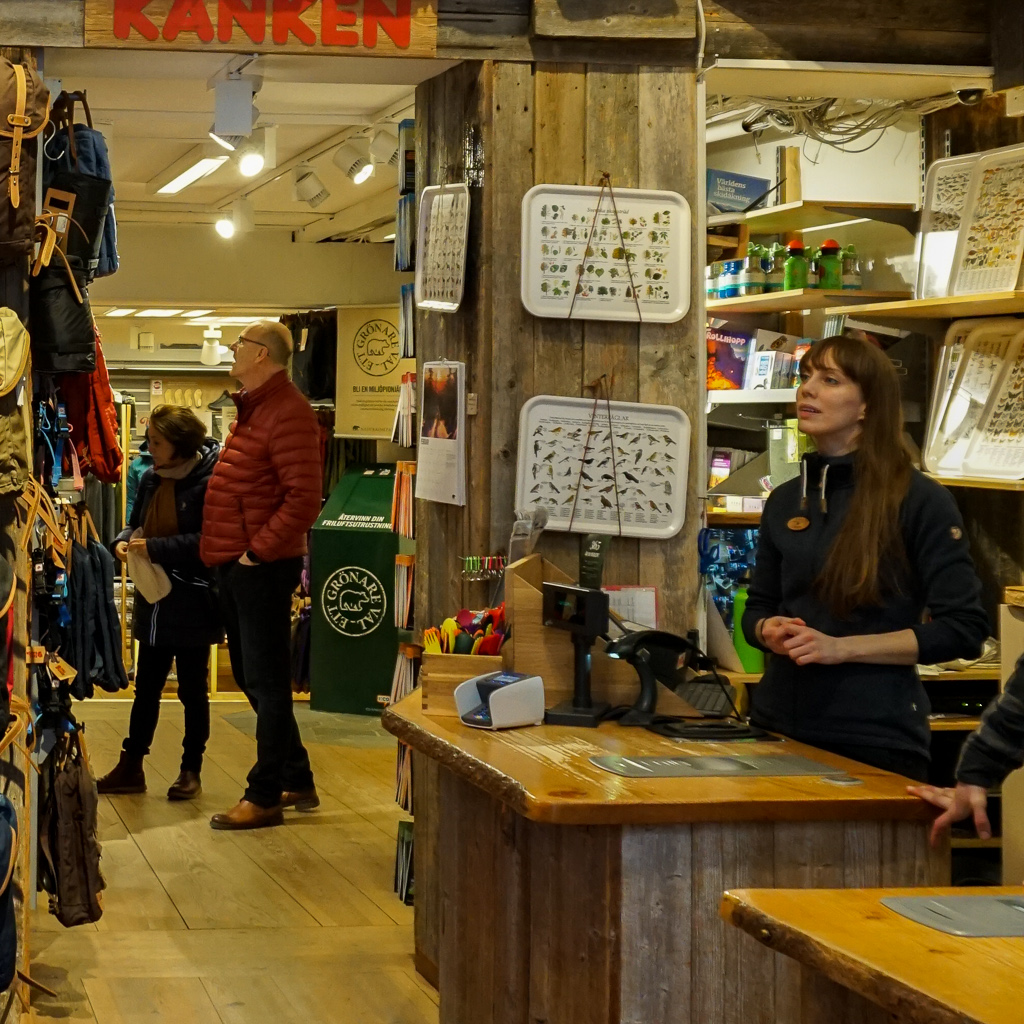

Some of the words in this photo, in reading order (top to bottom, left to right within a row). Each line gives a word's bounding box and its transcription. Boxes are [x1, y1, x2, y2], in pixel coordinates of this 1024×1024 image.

[717, 177, 746, 188] Världens
[706, 328, 746, 346] ROLLIHOPP
[337, 512, 372, 522] ÅTERVINN
[327, 571, 382, 604] GRÖNARE
[327, 605, 349, 629] ETT
[357, 609, 381, 630] VAL
